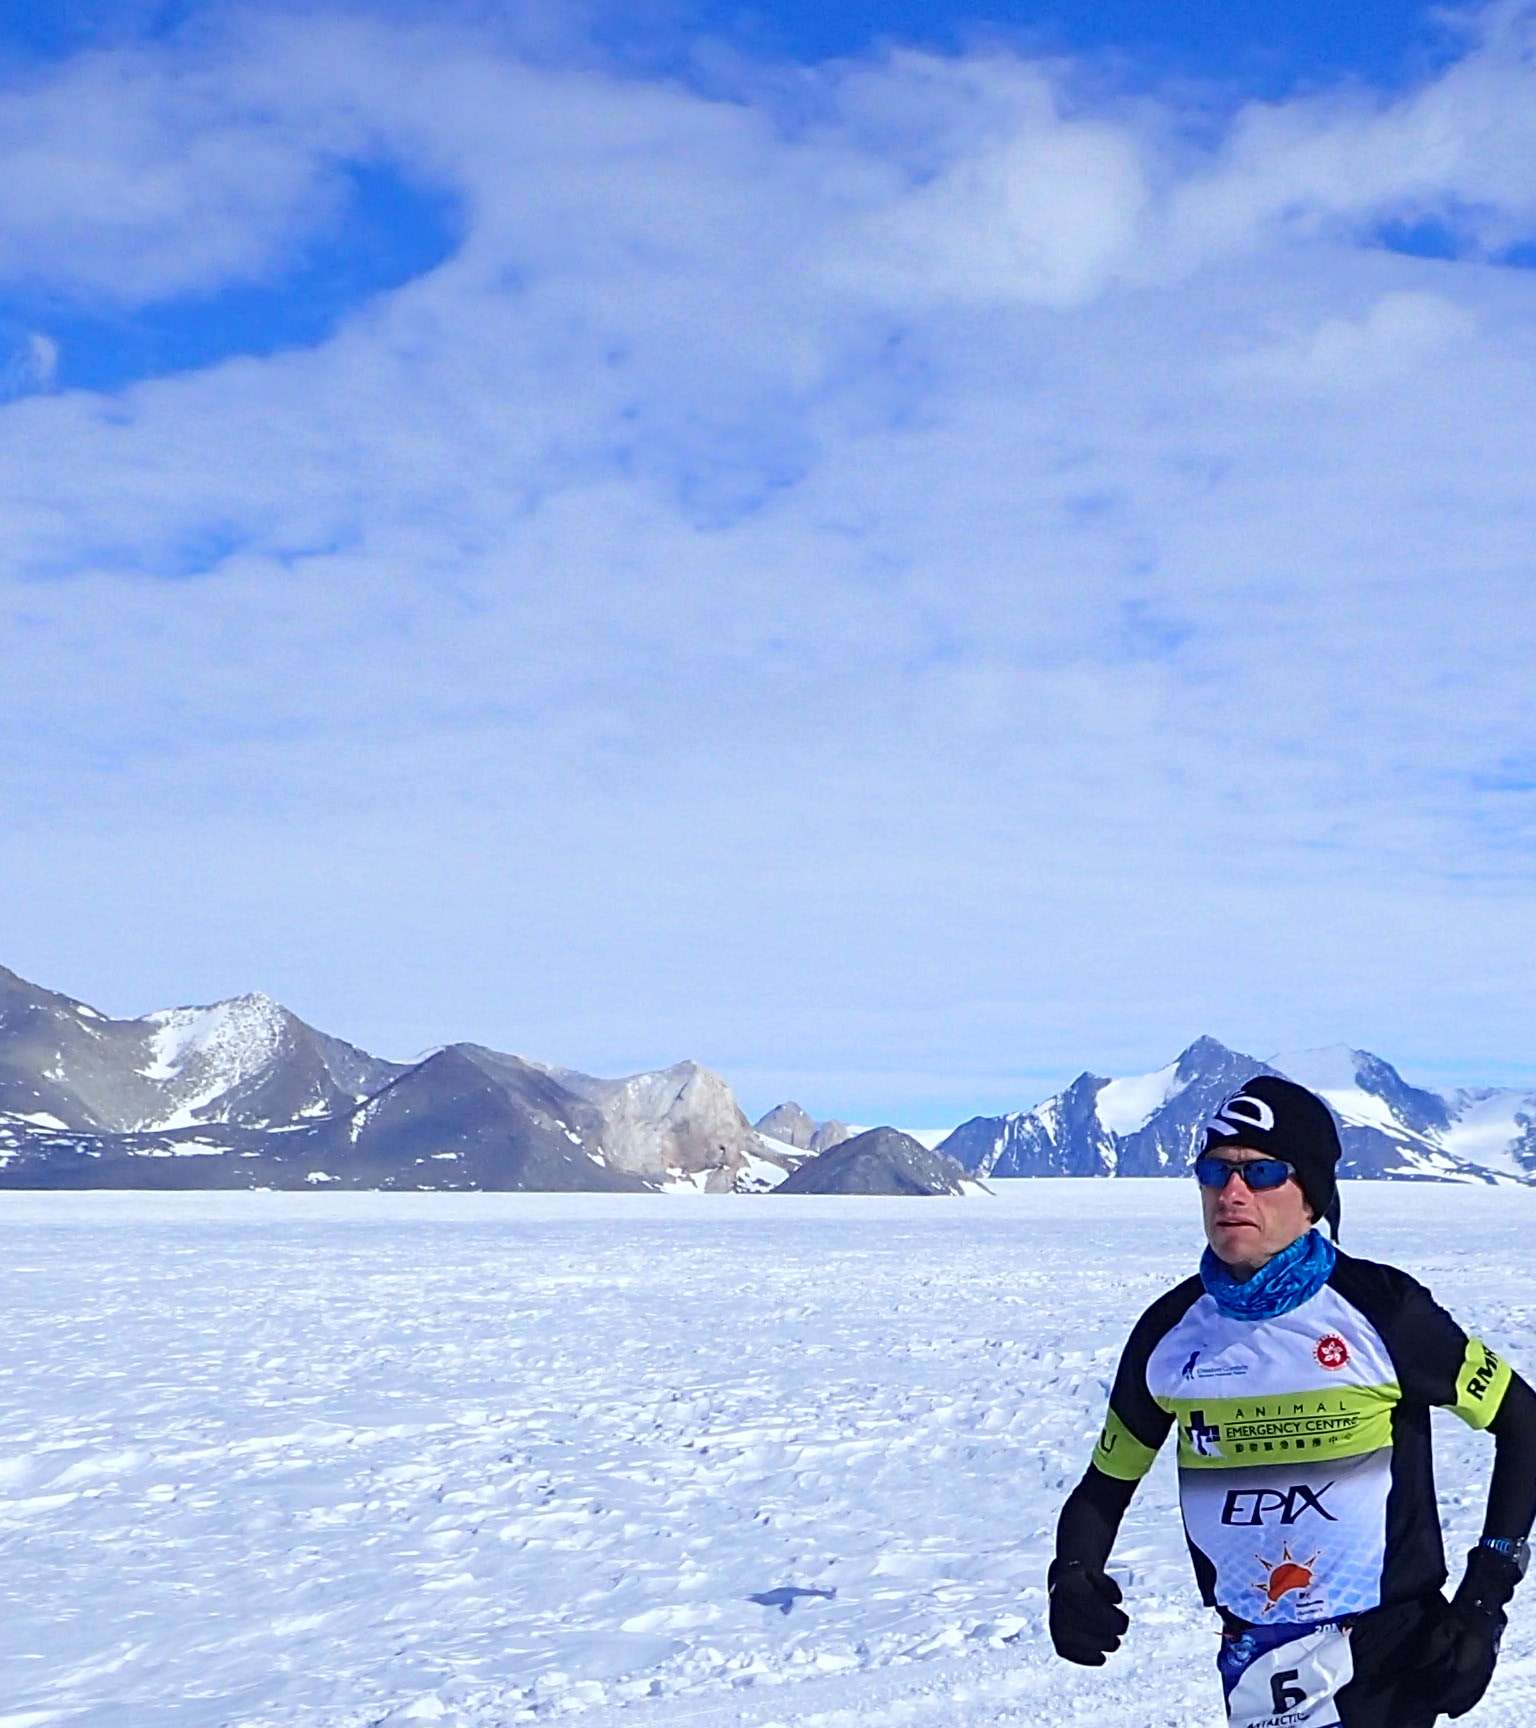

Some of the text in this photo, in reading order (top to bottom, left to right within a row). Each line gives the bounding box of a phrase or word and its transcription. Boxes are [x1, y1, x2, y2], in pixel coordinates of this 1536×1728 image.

[1235, 1400, 1346, 1419] ANIMAL
[1226, 1422, 1301, 1438] EMERGENCY
[1221, 1481, 1339, 1525] EPIX
[1270, 1669, 1307, 1714] 6
